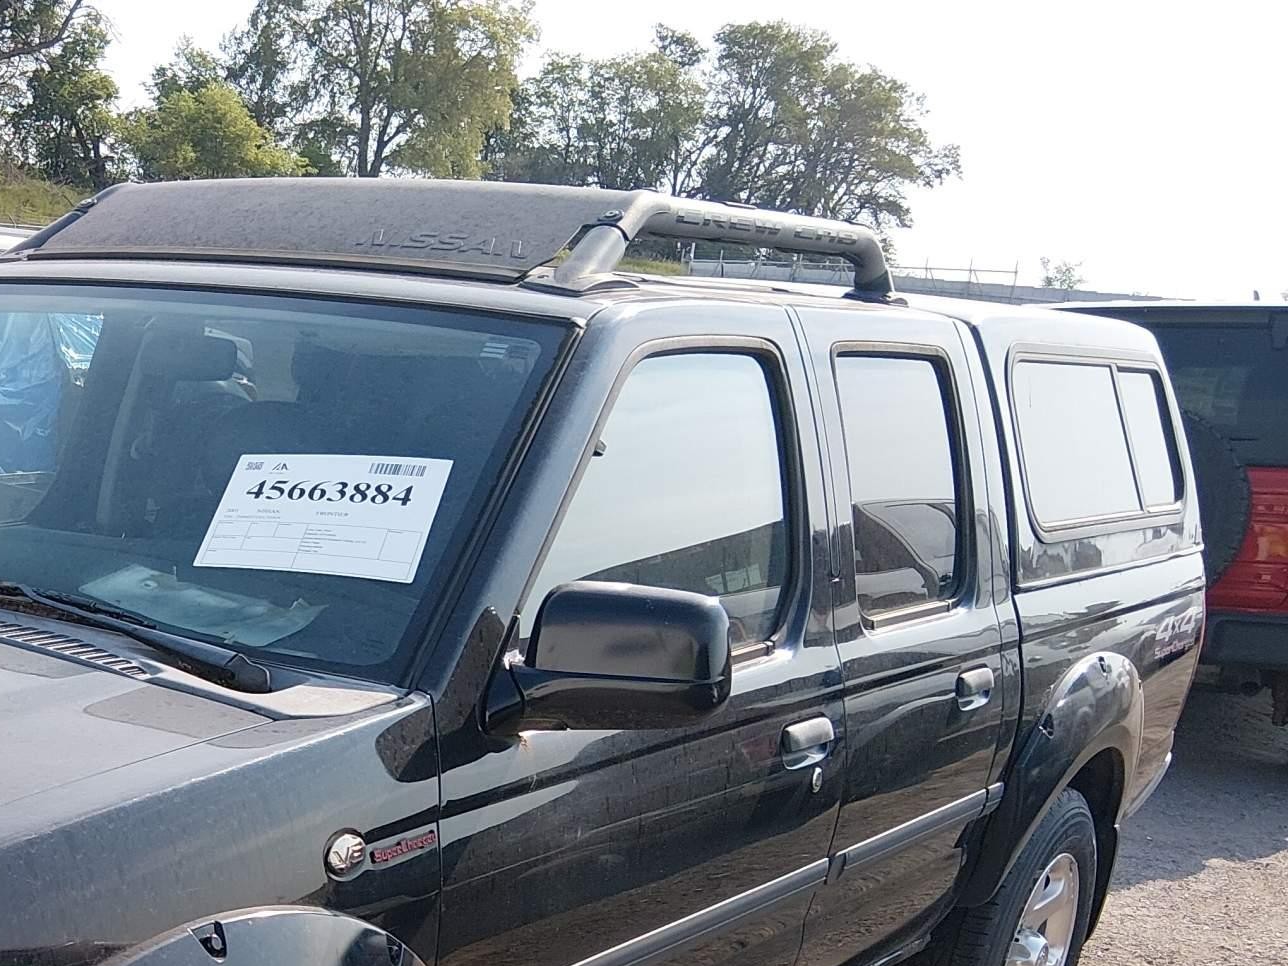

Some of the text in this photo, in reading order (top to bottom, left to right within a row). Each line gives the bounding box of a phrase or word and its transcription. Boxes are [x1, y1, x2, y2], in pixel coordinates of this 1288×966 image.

[675, 208, 858, 246] CREW CAB
[245, 479, 414, 507] 45663884
[1155, 607, 1198, 642] 4x4
